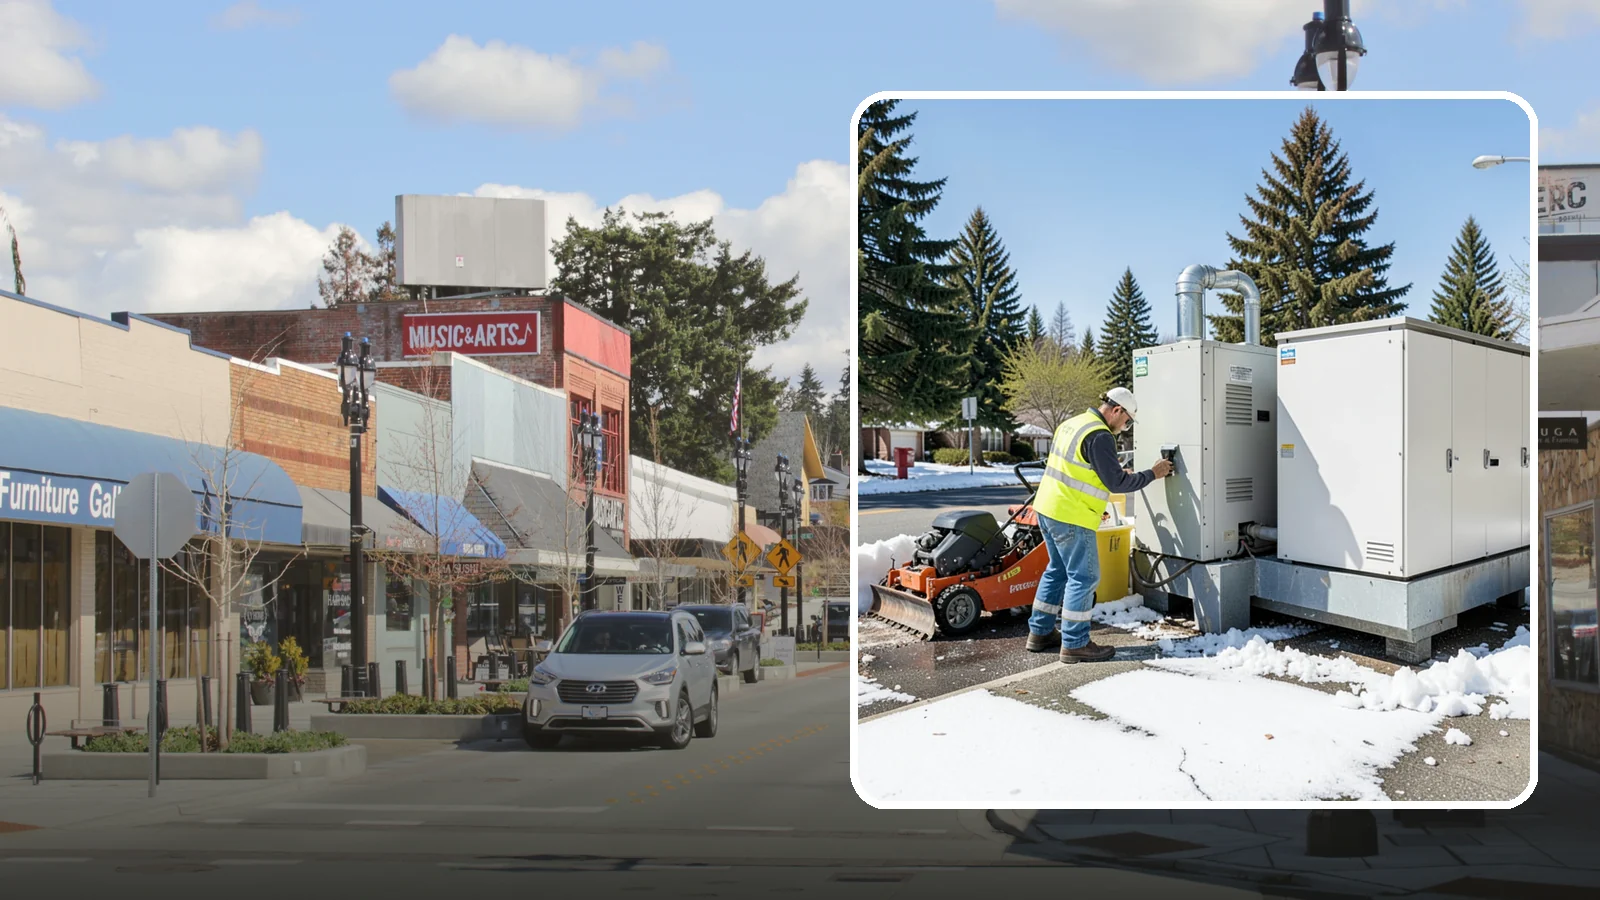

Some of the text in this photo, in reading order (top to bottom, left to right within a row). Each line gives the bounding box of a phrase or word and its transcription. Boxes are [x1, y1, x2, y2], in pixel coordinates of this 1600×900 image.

[408, 322, 520, 349] MUSIC&ARTS
[1540, 427, 1578, 437] UGA
[0, 471, 122, 519] Furniture Gal
[453, 563, 480, 575] SUSHI
